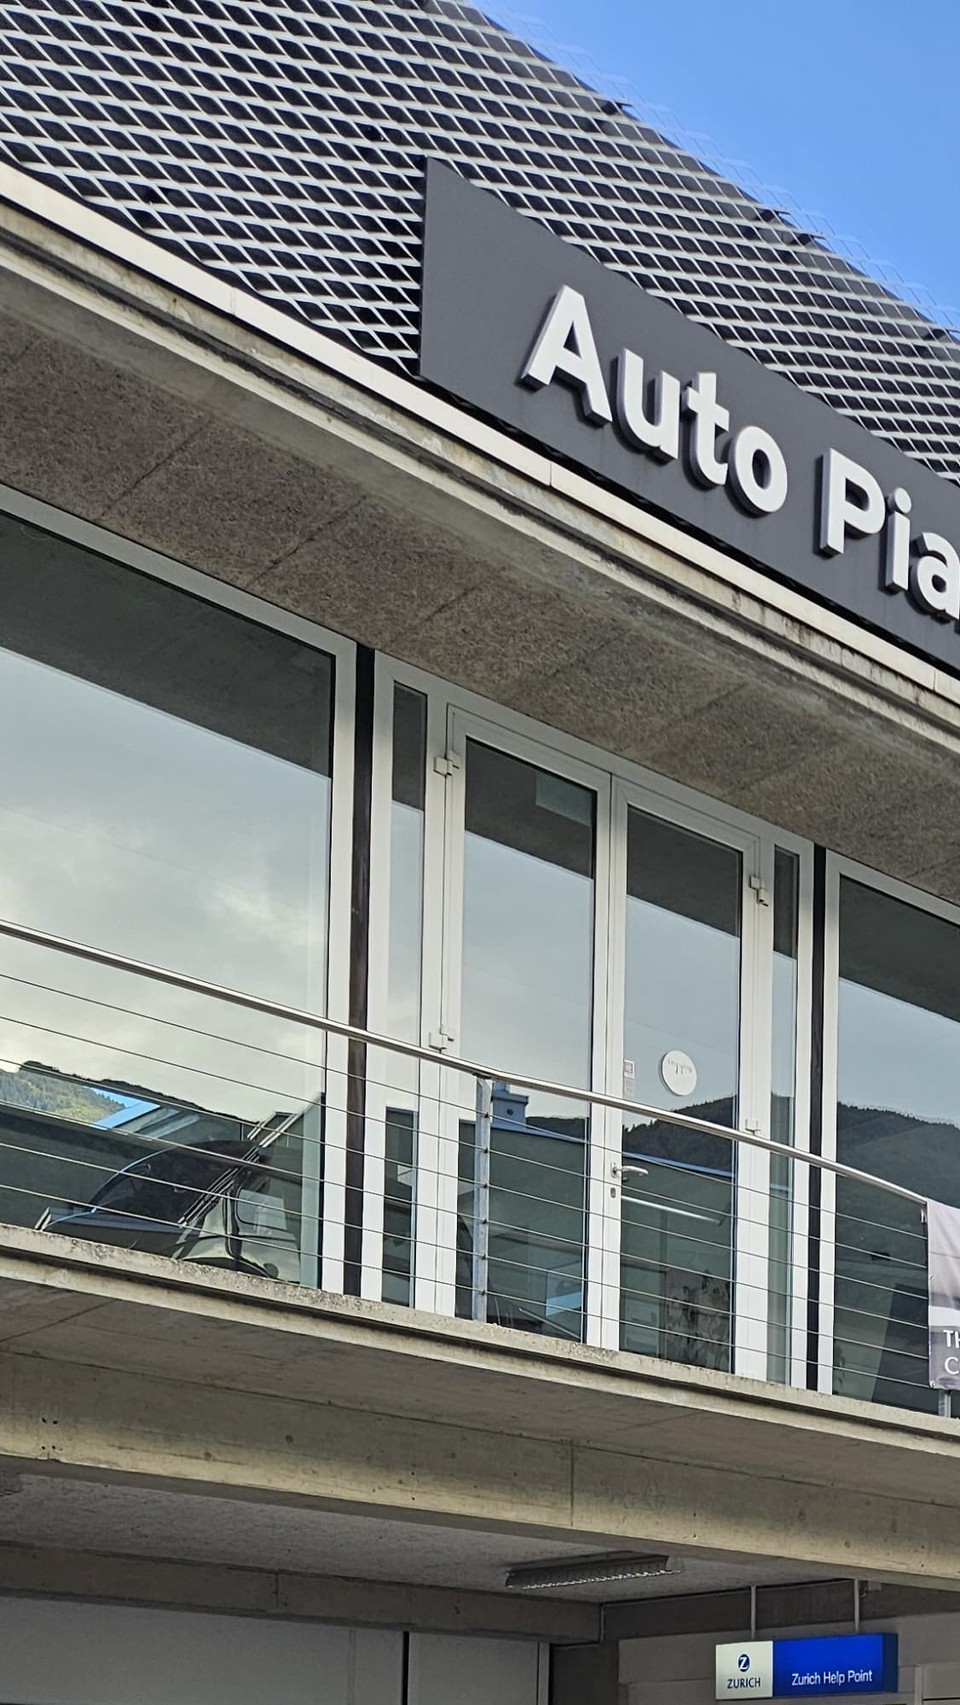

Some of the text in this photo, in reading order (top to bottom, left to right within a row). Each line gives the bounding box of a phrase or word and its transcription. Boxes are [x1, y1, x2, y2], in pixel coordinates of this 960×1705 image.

[522, 285, 787, 514] Auto
[727, 1677, 761, 1689] ZURICH
[791, 1669, 873, 1686] Zurich Help Point
